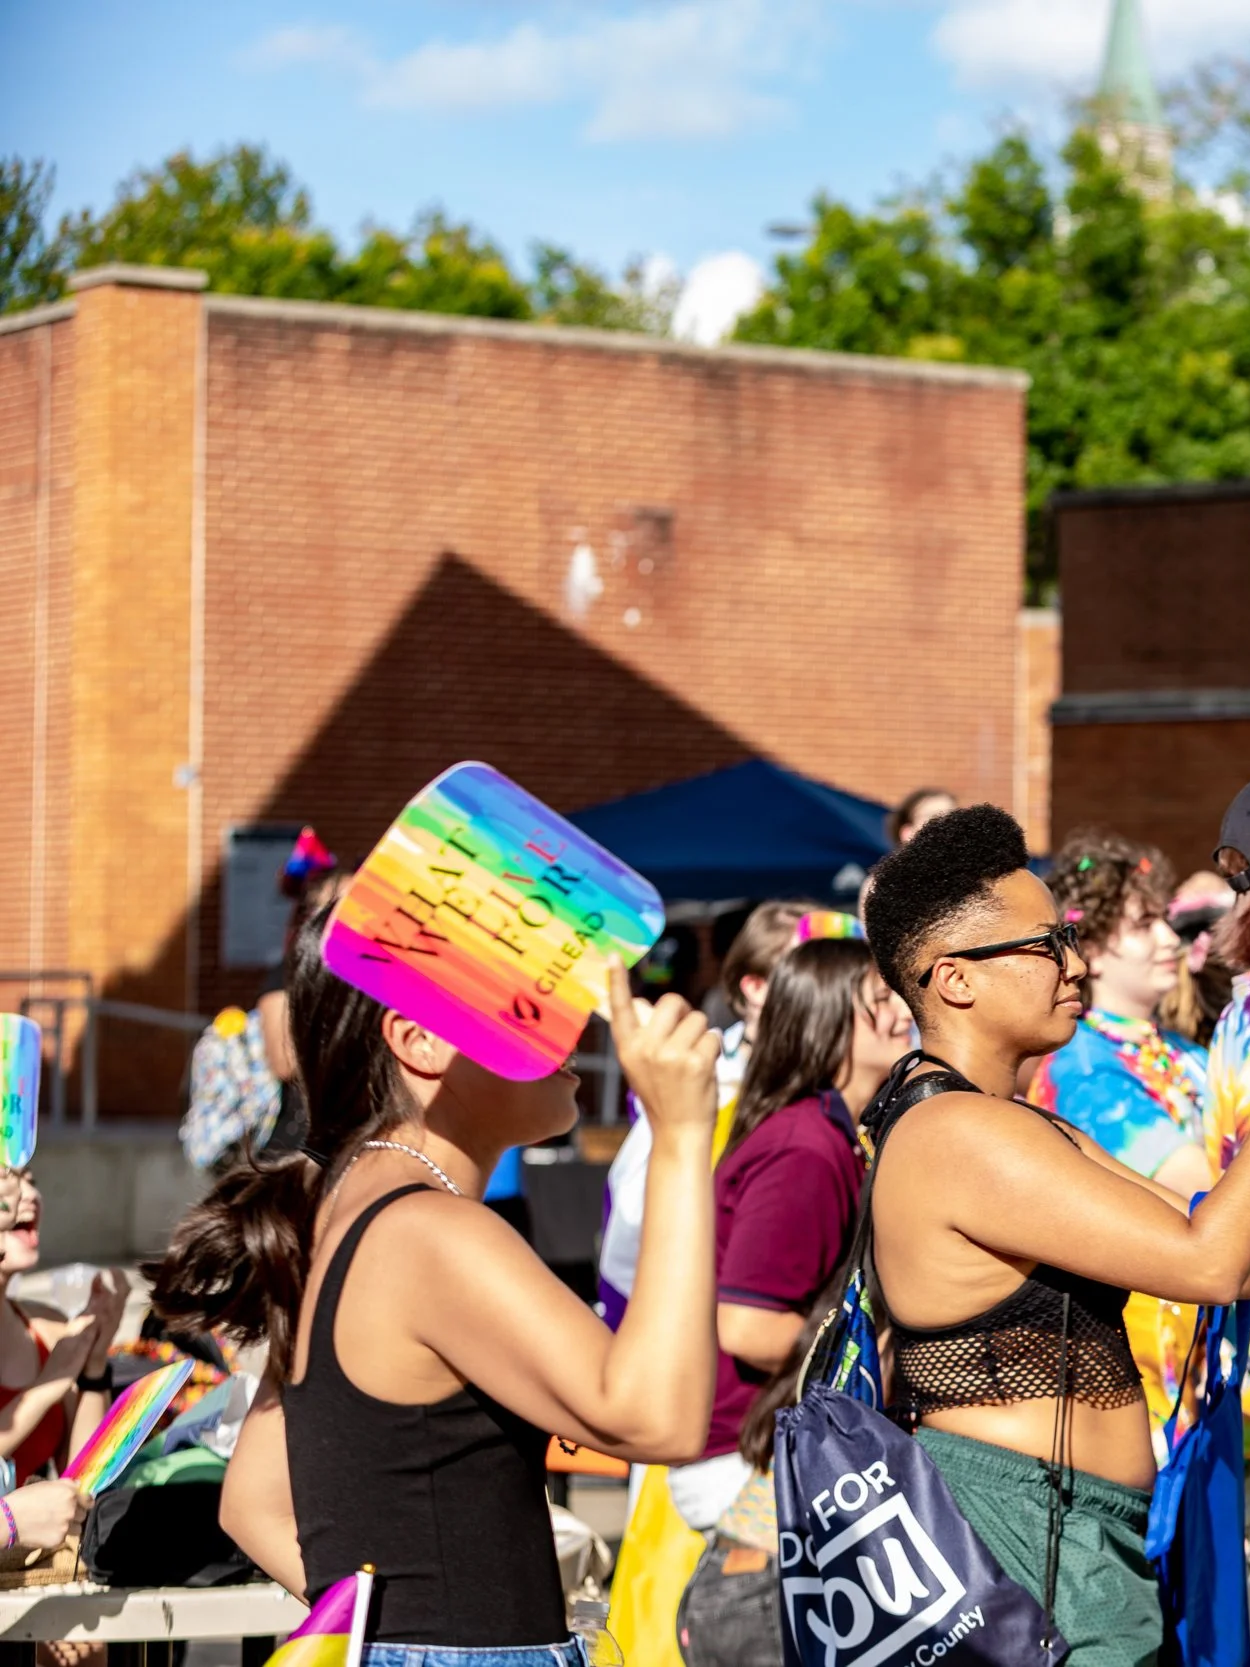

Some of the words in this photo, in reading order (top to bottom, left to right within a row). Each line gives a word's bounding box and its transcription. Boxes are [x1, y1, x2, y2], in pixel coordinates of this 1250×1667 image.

[358, 826, 479, 961] WHAT
[405, 886, 481, 955] WE
[467, 827, 566, 938] LIVE
[493, 861, 588, 956] FOR
[535, 910, 603, 994] GILEAD
[811, 1460, 896, 1531] FOR
[915, 1605, 985, 1666] County
